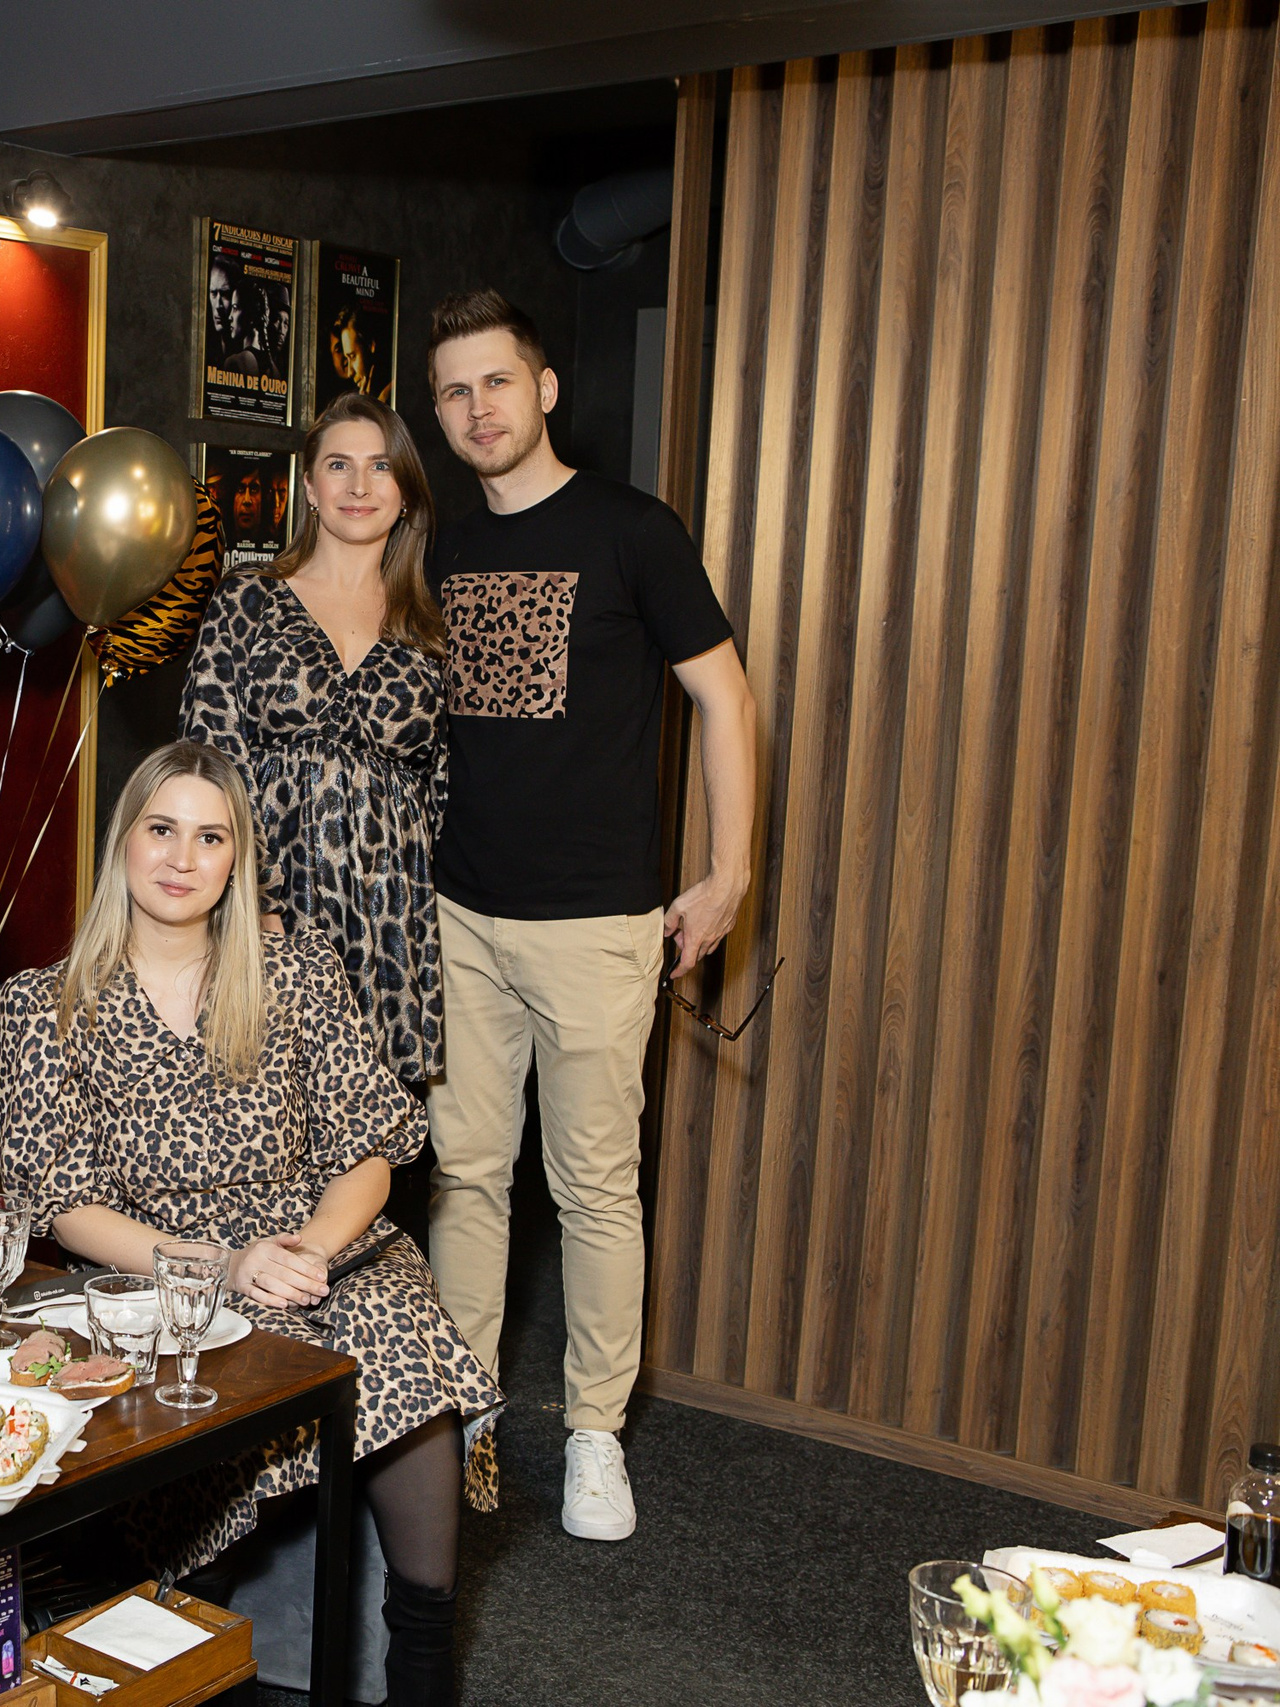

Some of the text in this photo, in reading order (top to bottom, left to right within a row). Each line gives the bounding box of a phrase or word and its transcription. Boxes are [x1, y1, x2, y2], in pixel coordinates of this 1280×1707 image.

[213, 222, 222, 241] 7
[272, 235, 294, 249] OSCAR
[361, 265, 369, 277] A
[341, 272, 380, 290] BEAUTIFUL
[355, 286, 376, 298] MIND
[206, 365, 288, 395] MENINA DE OURO
